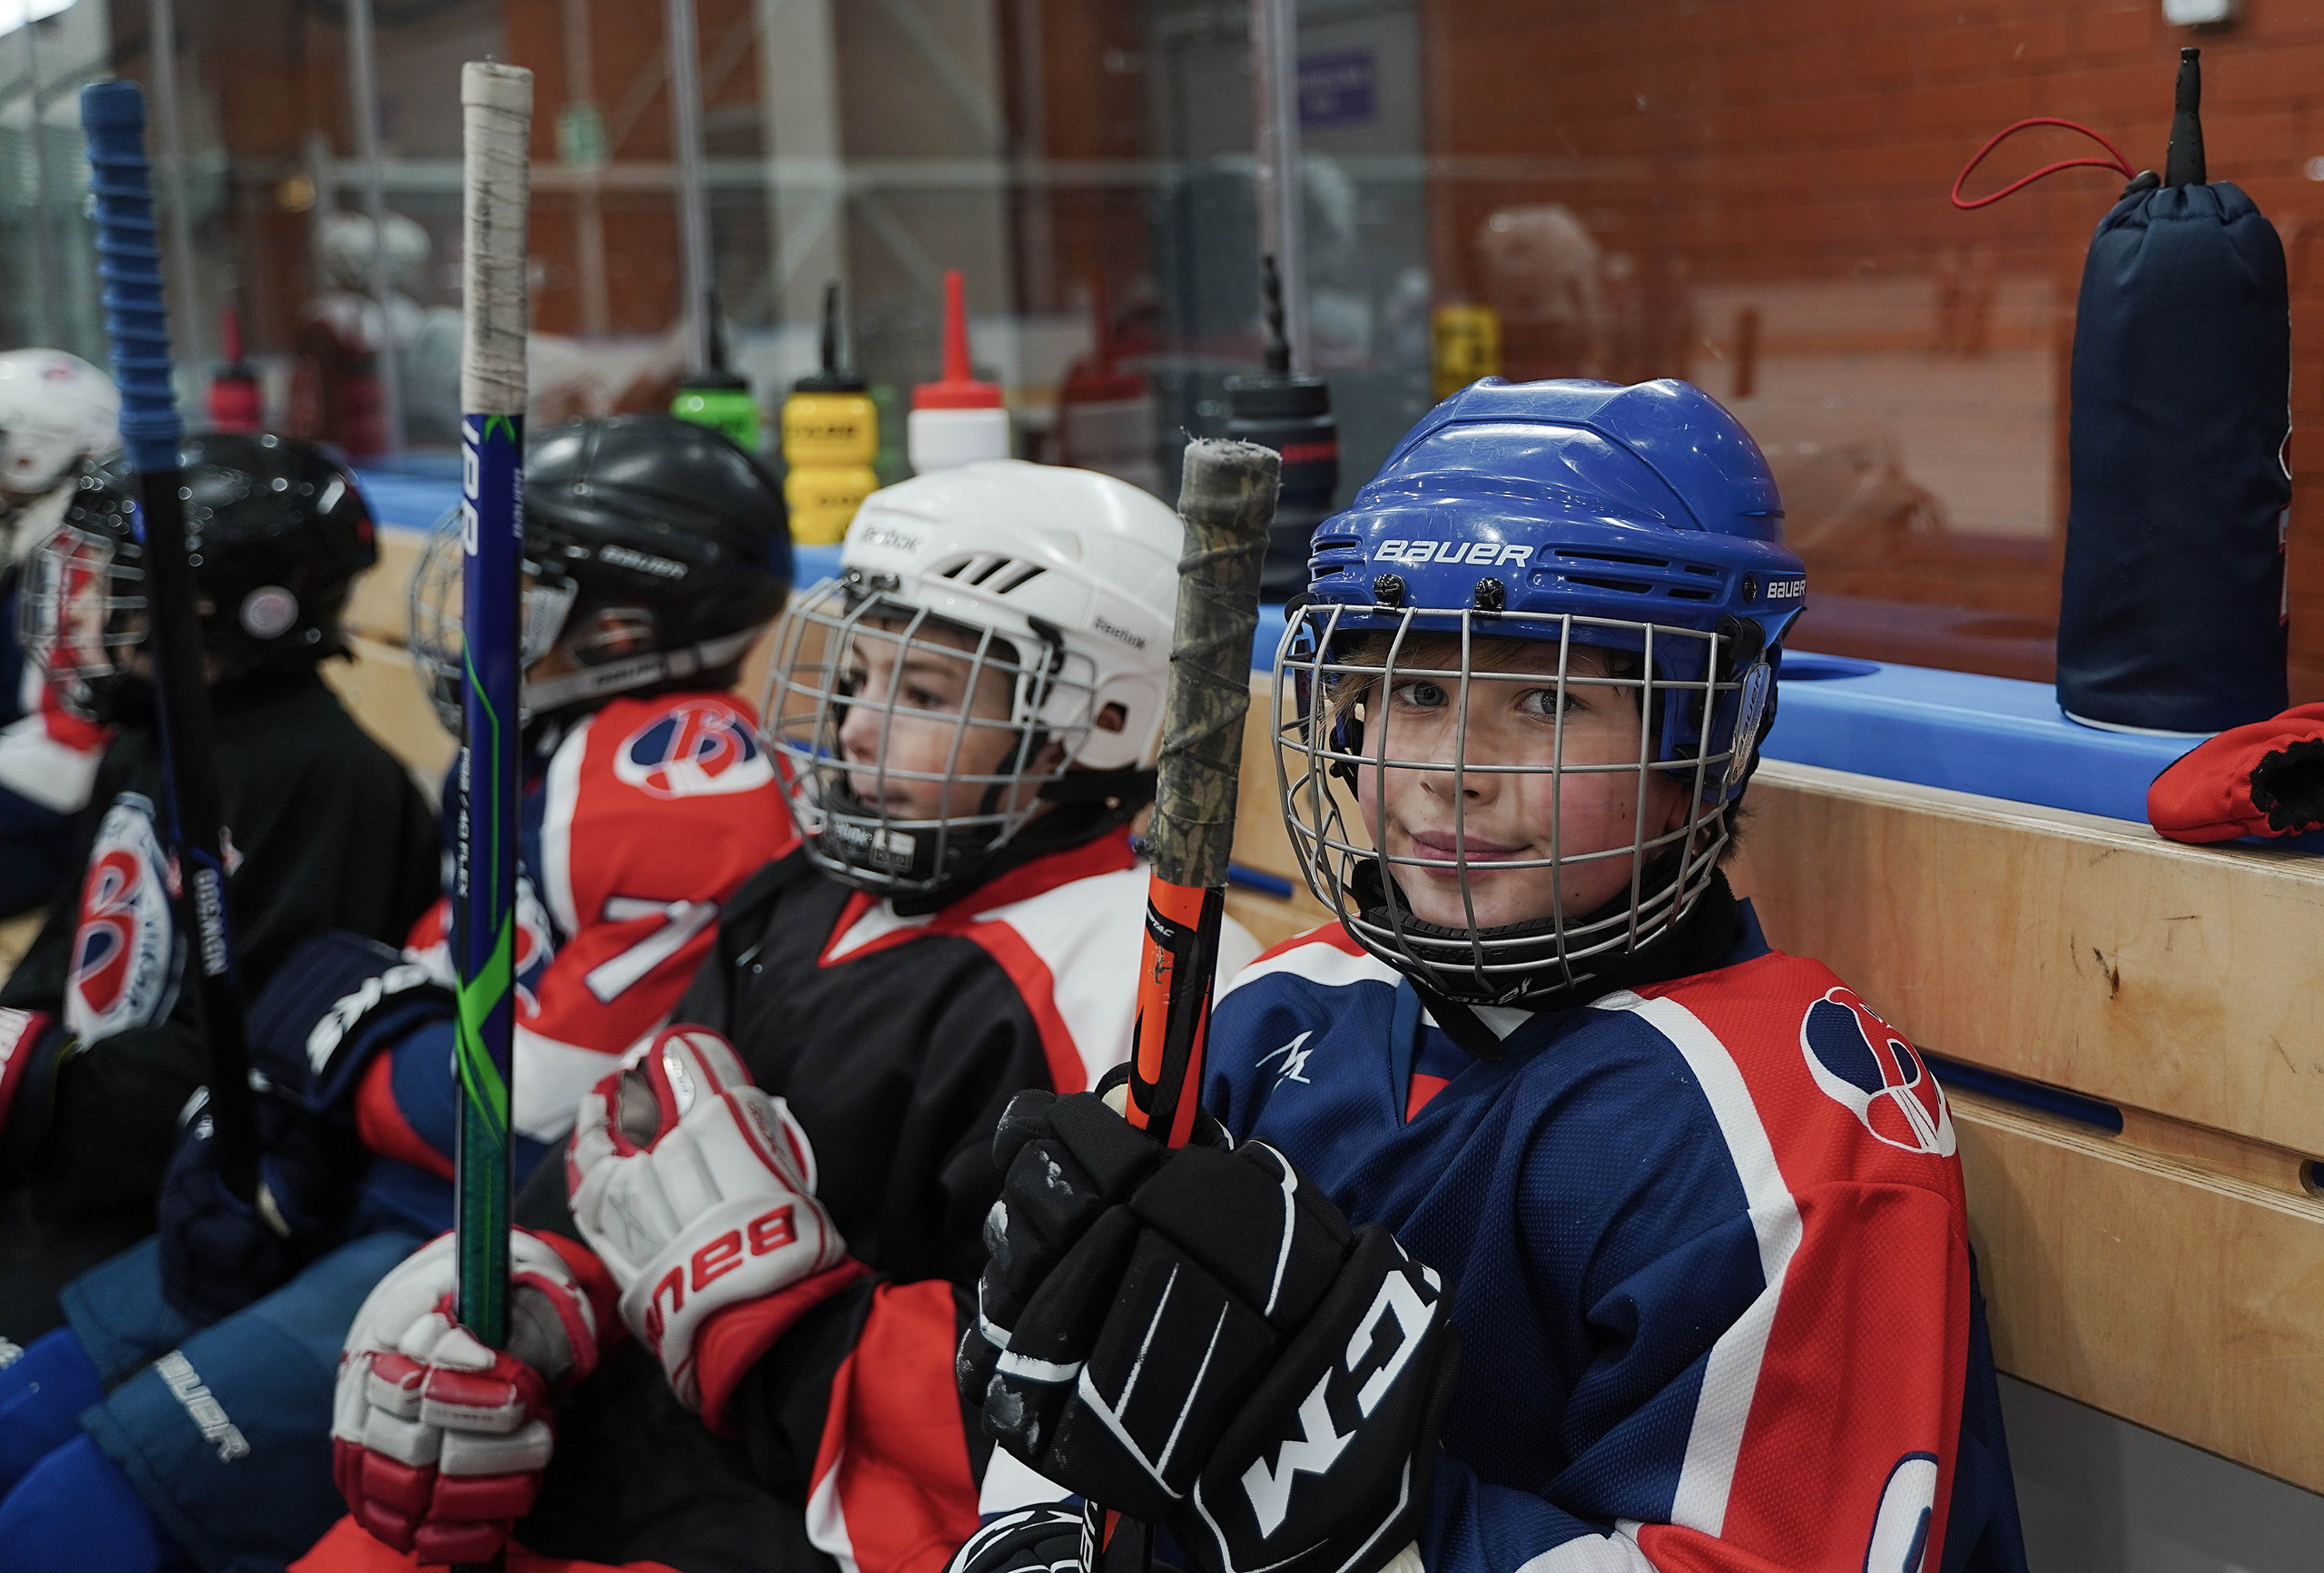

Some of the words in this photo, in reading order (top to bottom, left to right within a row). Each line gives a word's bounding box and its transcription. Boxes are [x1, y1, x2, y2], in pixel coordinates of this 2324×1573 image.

[1373, 539, 1534, 567] BAUER
[1767, 579, 1807, 599] BAUER
[645, 1203, 799, 1352] BAU
[154, 1349, 251, 1464] AUER
[1240, 1266, 1442, 1539] CM
